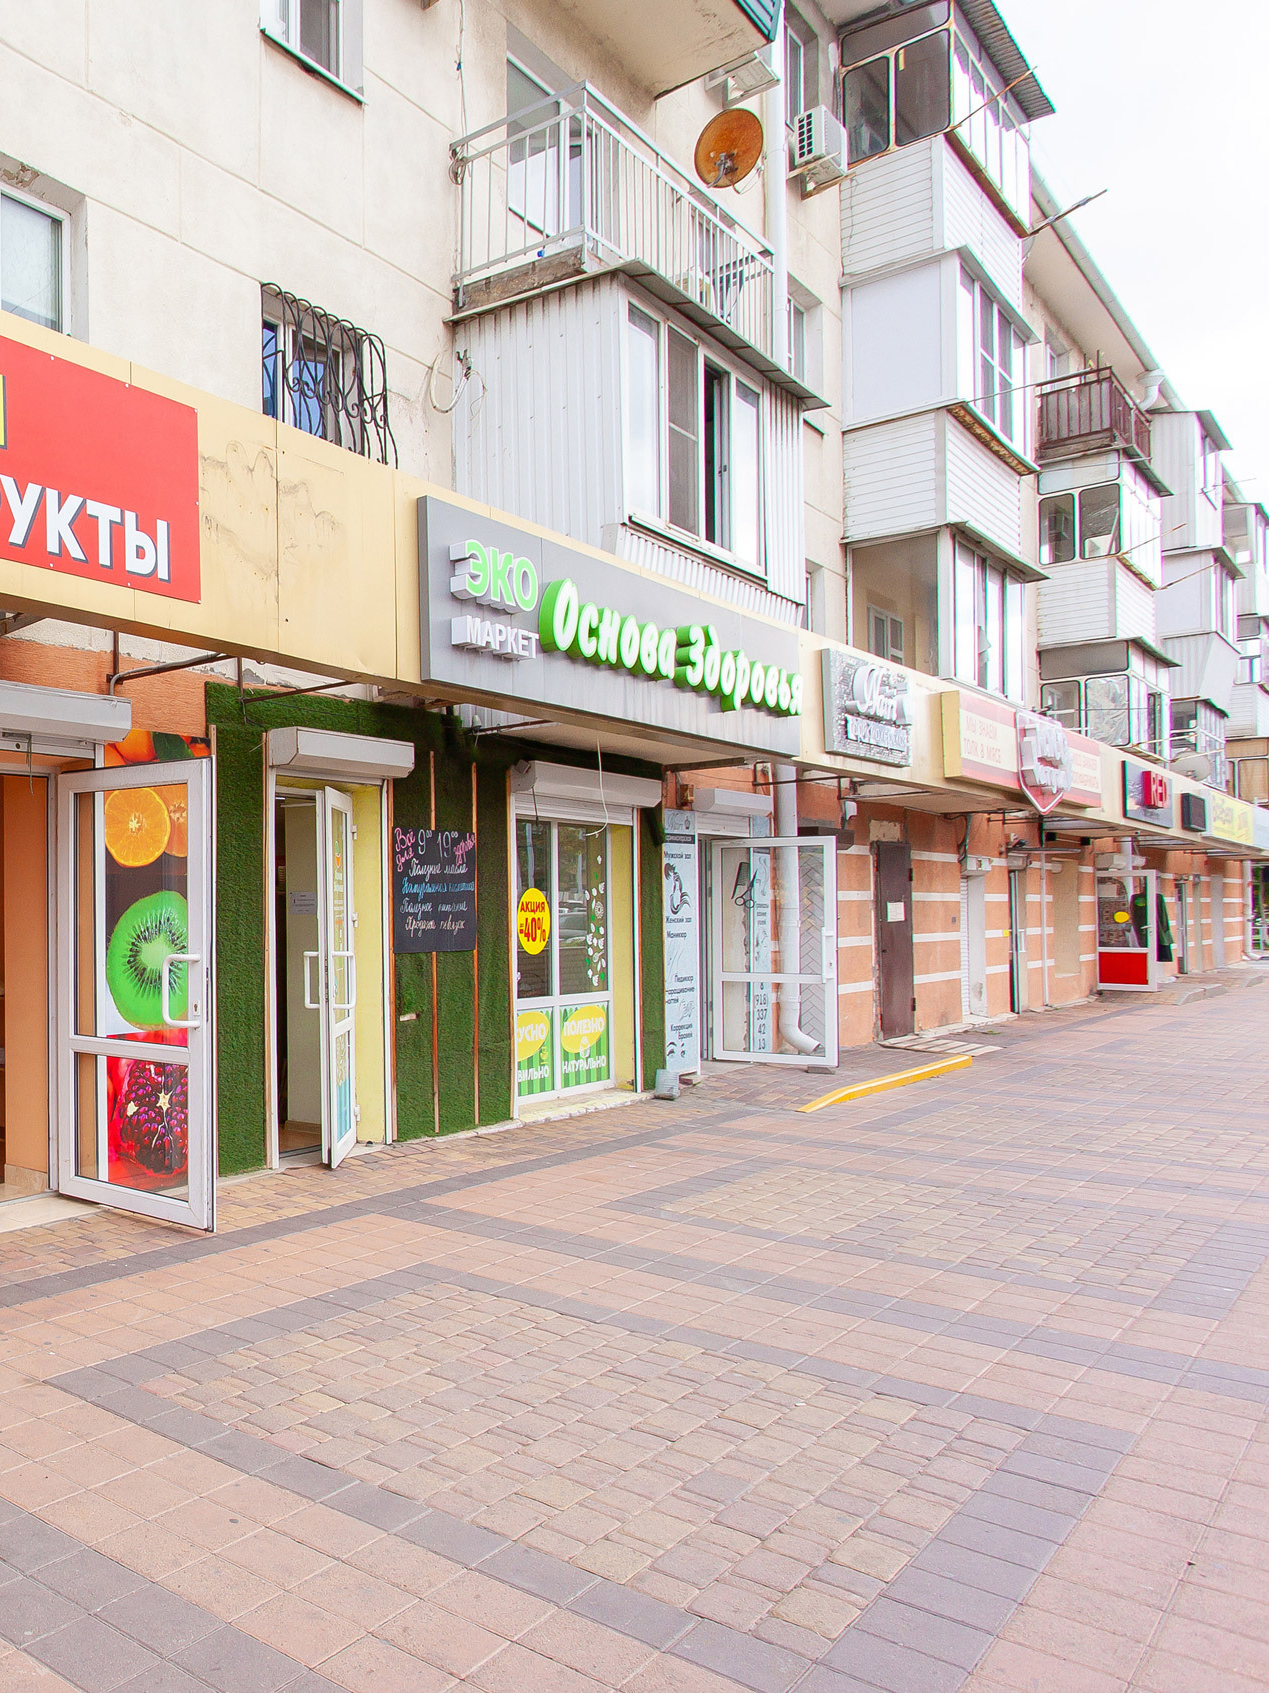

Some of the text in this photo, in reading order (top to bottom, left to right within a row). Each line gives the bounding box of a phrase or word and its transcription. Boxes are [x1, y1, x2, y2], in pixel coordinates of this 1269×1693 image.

[452, 539, 539, 613] ЭКО
[453, 615, 540, 661] МАРКЕТ
[541, 578, 678, 681] Основа
[676, 624, 804, 717] Здоровья
[520, 901, 546, 914] АКЦИЯ
[756, 1009, 768, 1020] 337
[563, 1017, 606, 1034] ПОЛЕЗНО
[758, 1024, 766, 1035] 42
[758, 1038, 766, 1050] 13
[562, 1055, 607, 1075] НАТУРАЛЬНО
